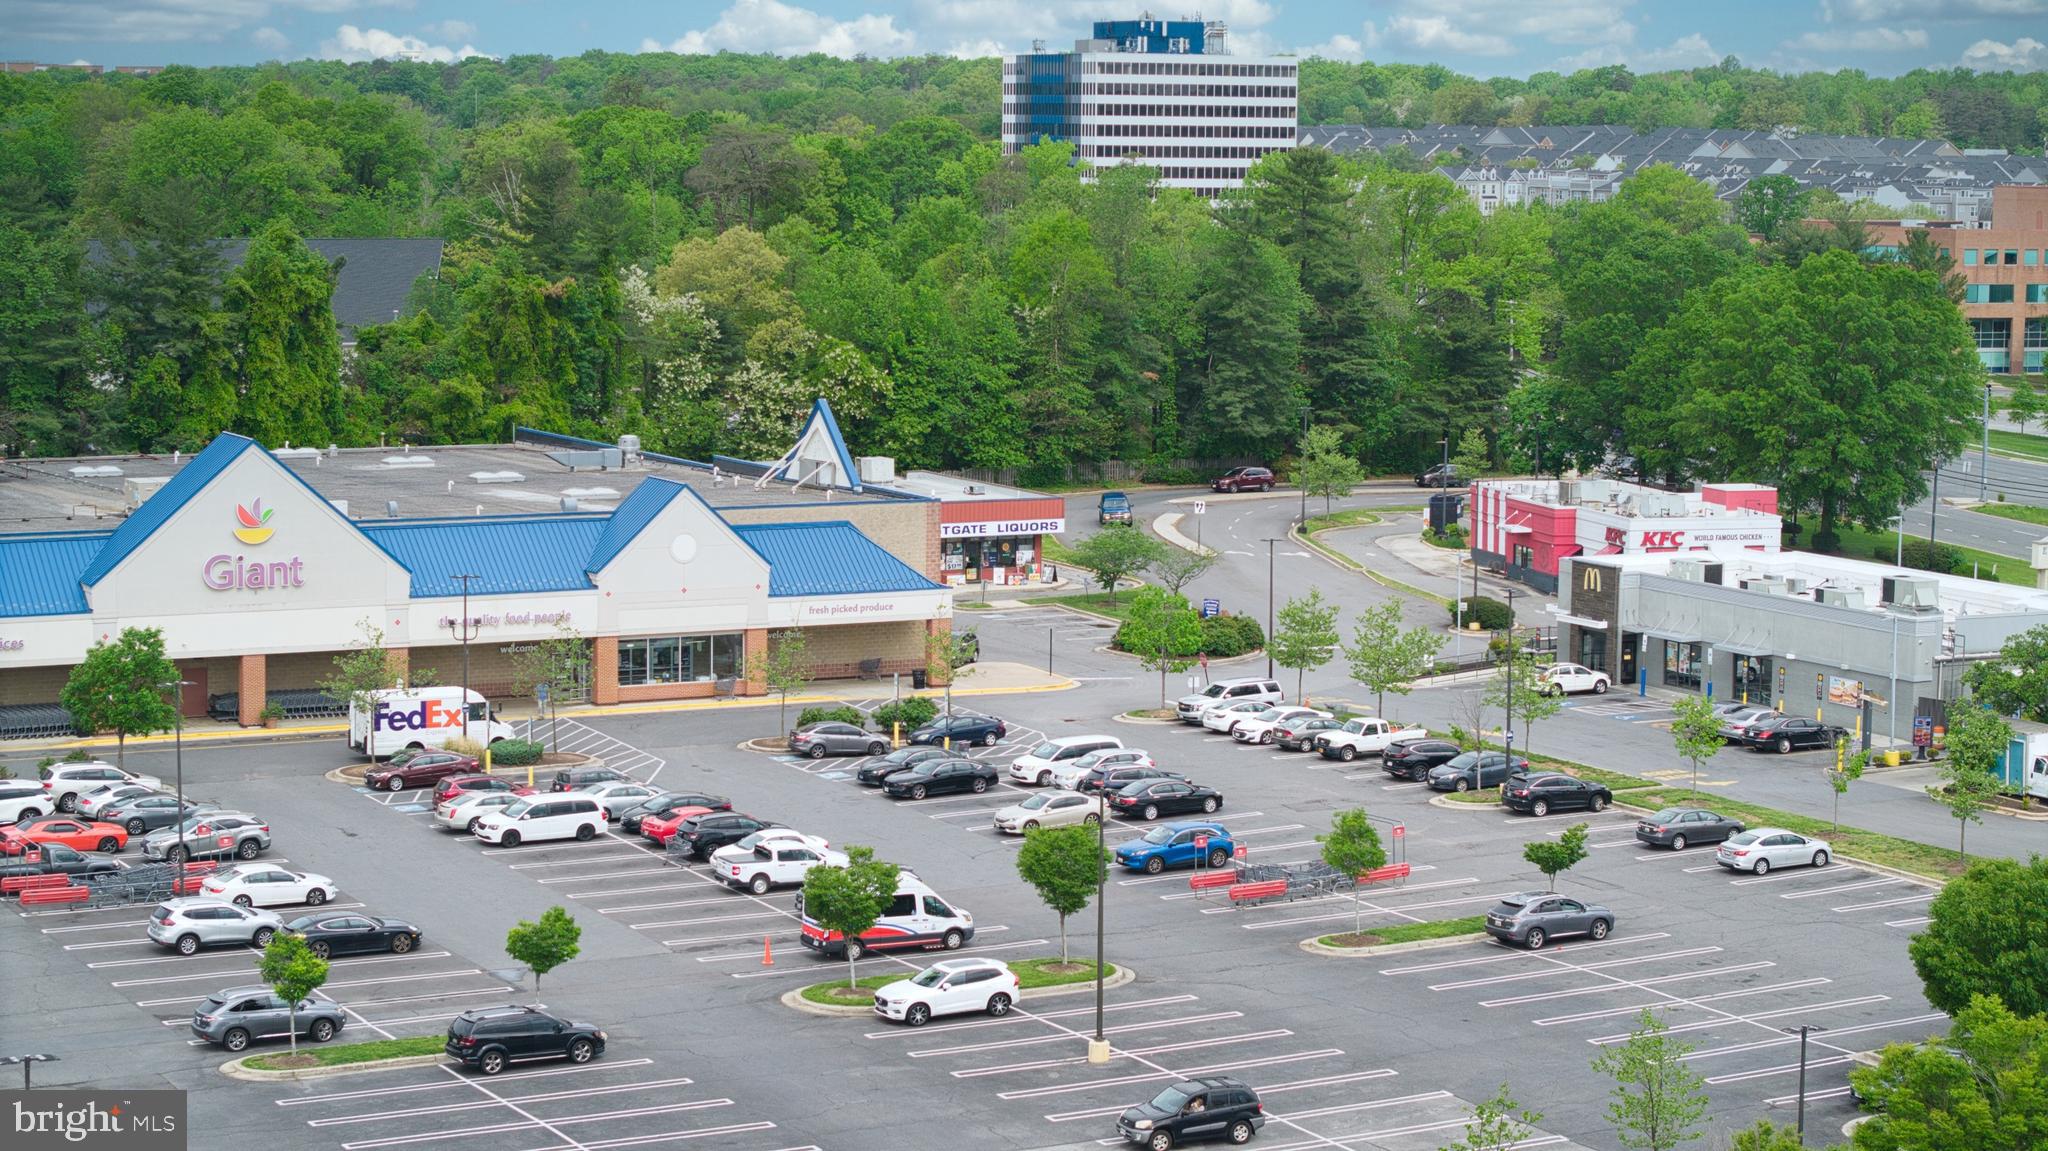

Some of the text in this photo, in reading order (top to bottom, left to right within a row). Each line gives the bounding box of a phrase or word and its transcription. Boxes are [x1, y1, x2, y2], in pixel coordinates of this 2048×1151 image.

[997, 521, 1058, 533] LIQUORS
[1605, 527, 1627, 545] KFC
[1640, 531, 1685, 547] KFC
[1739, 533, 1763, 541] CHICKEN
[202, 553, 304, 590] Giant
[808, 603, 894, 616] fresh picked produce
[505, 610, 530, 625] food
[374, 699, 463, 732] FedEx
